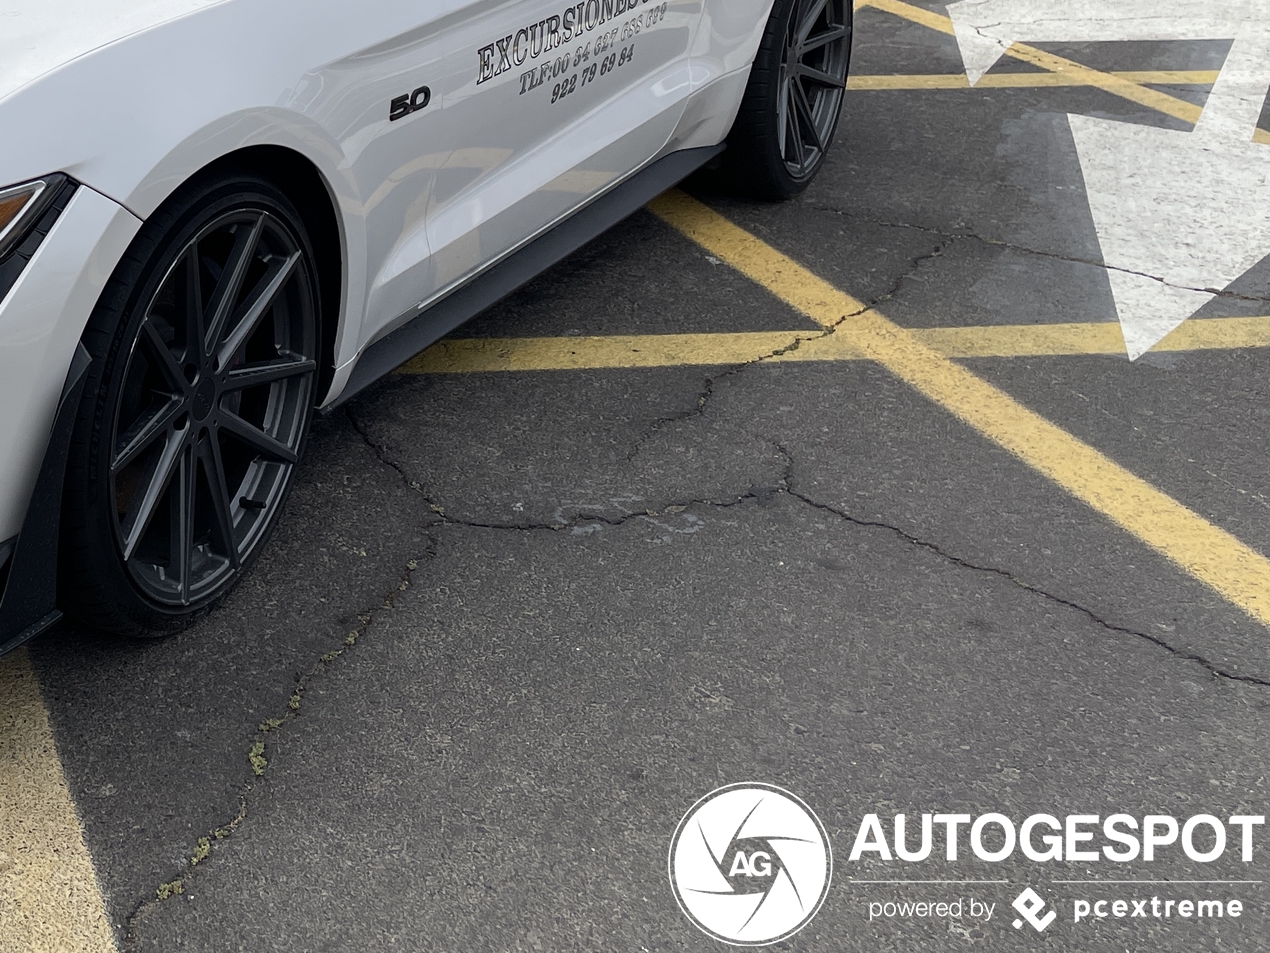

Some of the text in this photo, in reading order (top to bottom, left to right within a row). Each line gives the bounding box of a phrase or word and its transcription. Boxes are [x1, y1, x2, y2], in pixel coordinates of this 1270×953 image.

[550, 43, 635, 104] 922 79 69 84
[573, 41, 591, 68] 34
